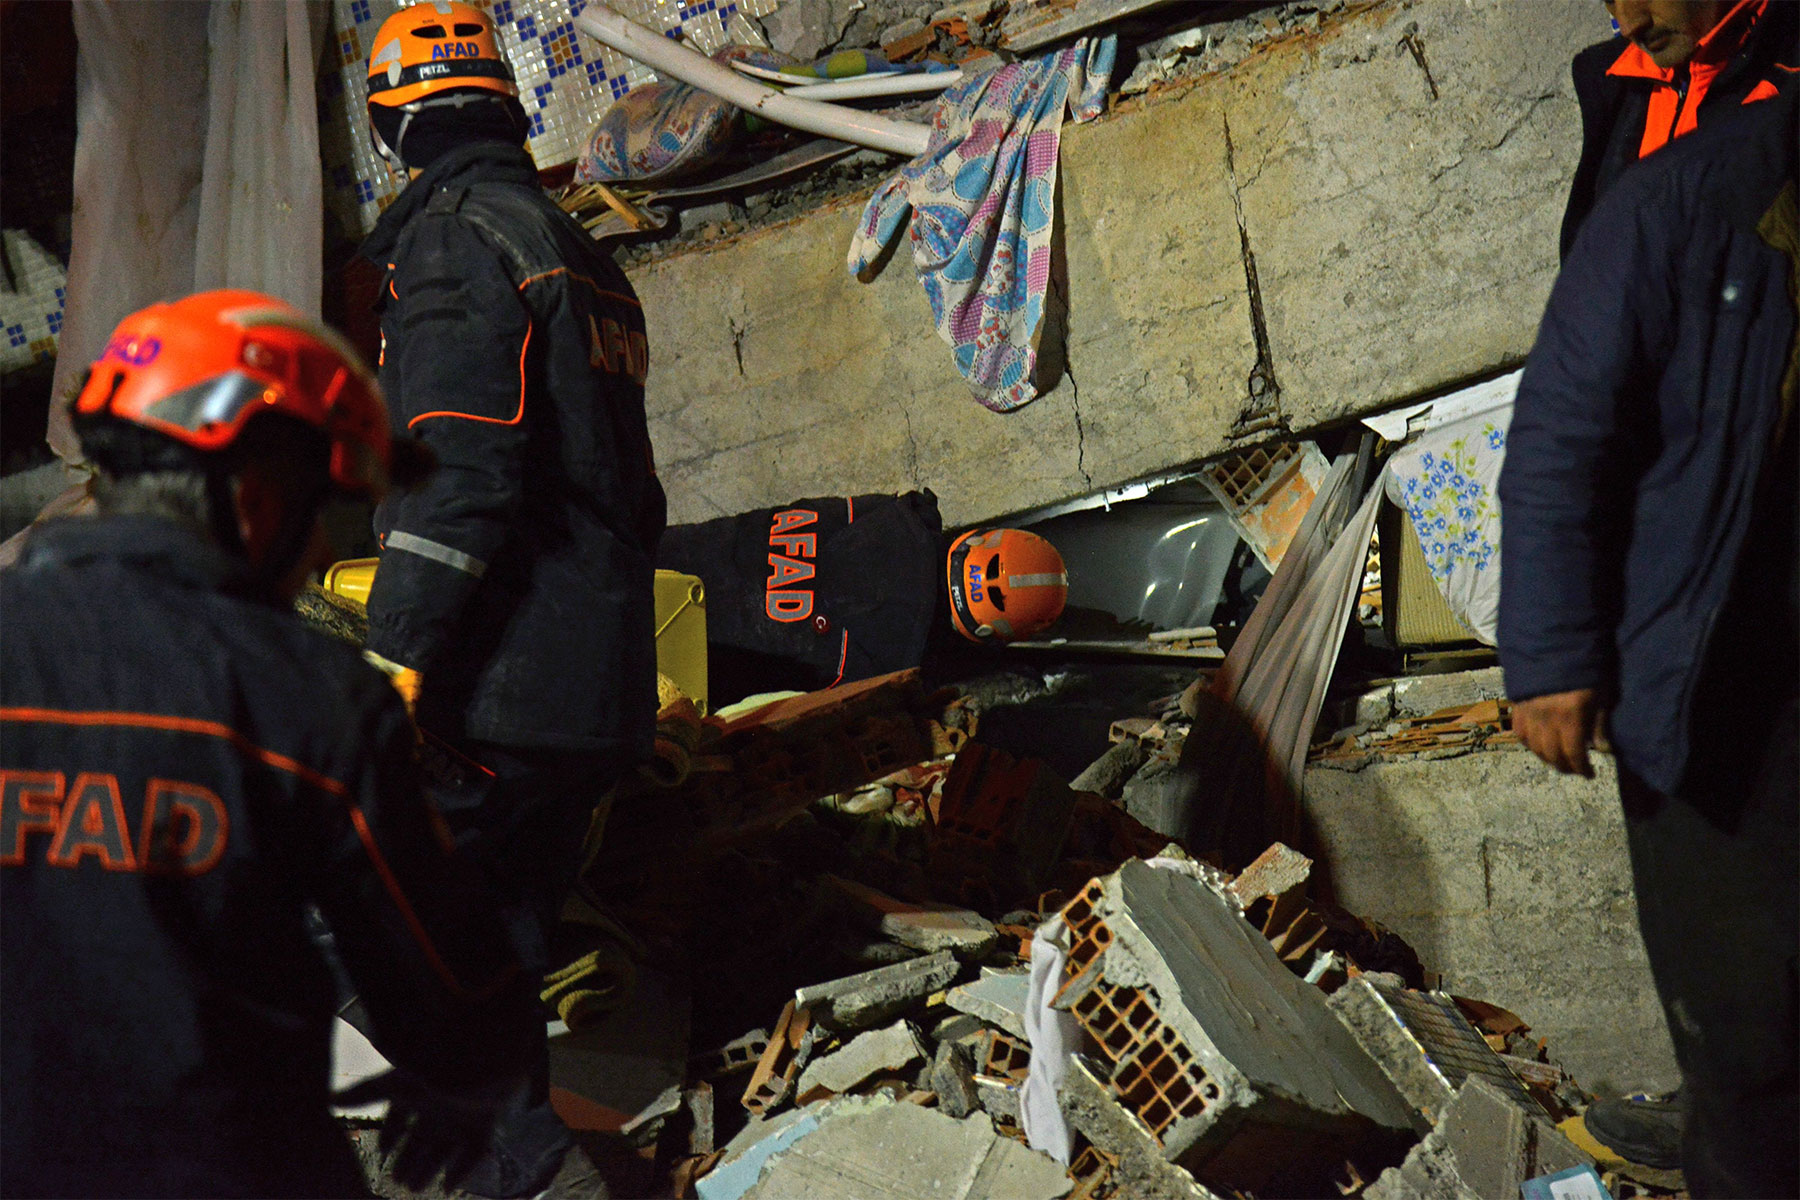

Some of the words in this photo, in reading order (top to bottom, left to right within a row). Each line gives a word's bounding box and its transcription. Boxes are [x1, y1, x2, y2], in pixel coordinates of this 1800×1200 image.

[432, 42, 480, 60] AFAD
[766, 509, 818, 623] AFAD
[969, 564, 983, 603] AFAD
